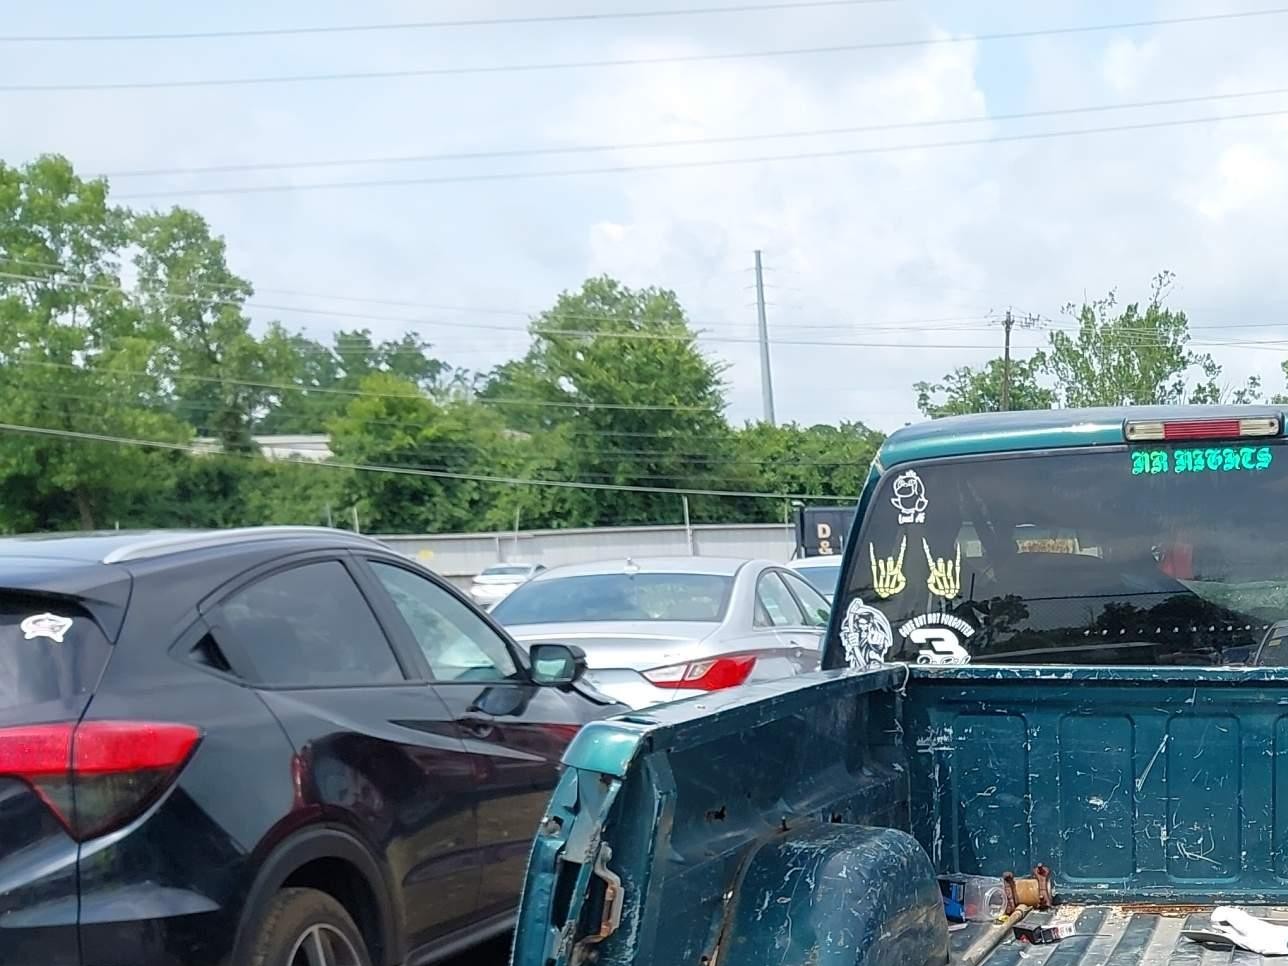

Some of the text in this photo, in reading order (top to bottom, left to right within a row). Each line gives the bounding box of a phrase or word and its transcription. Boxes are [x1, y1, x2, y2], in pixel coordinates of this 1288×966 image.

[1174, 447, 1273, 473] NIGHTS
[817, 523, 834, 554] D &
[898, 612, 976, 638] GONE BUT NOT FORGOTTEN
[910, 628, 969, 664] 3
